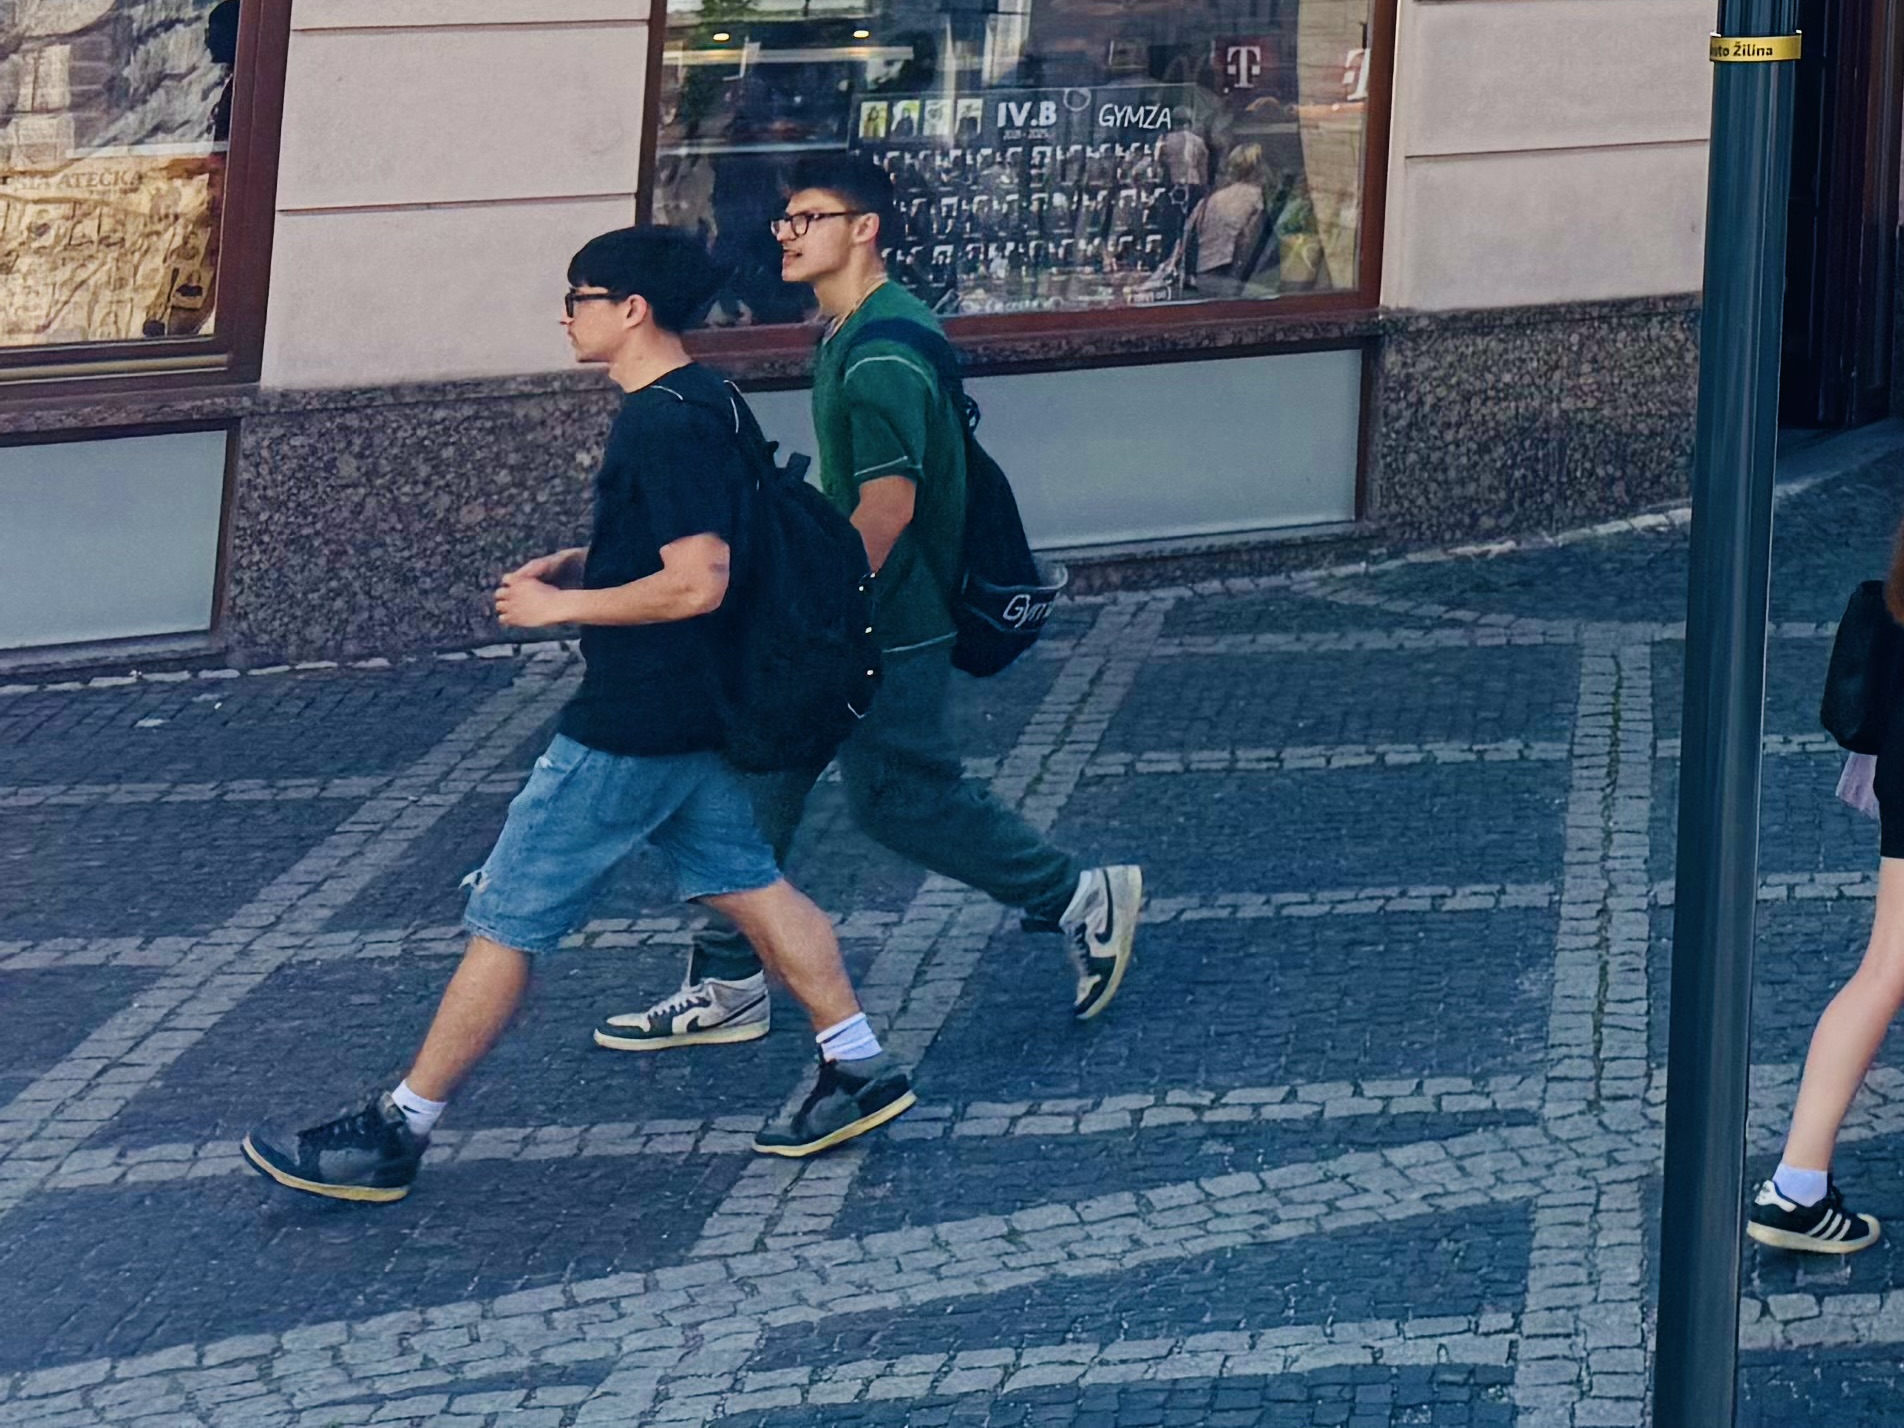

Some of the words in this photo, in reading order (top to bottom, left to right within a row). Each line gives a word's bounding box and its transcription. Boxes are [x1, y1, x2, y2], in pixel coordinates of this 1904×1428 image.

[1733, 41, 1773, 57] Žilina
[996, 101, 1057, 128] IV.B
[1099, 102, 1172, 129] GYMZA
